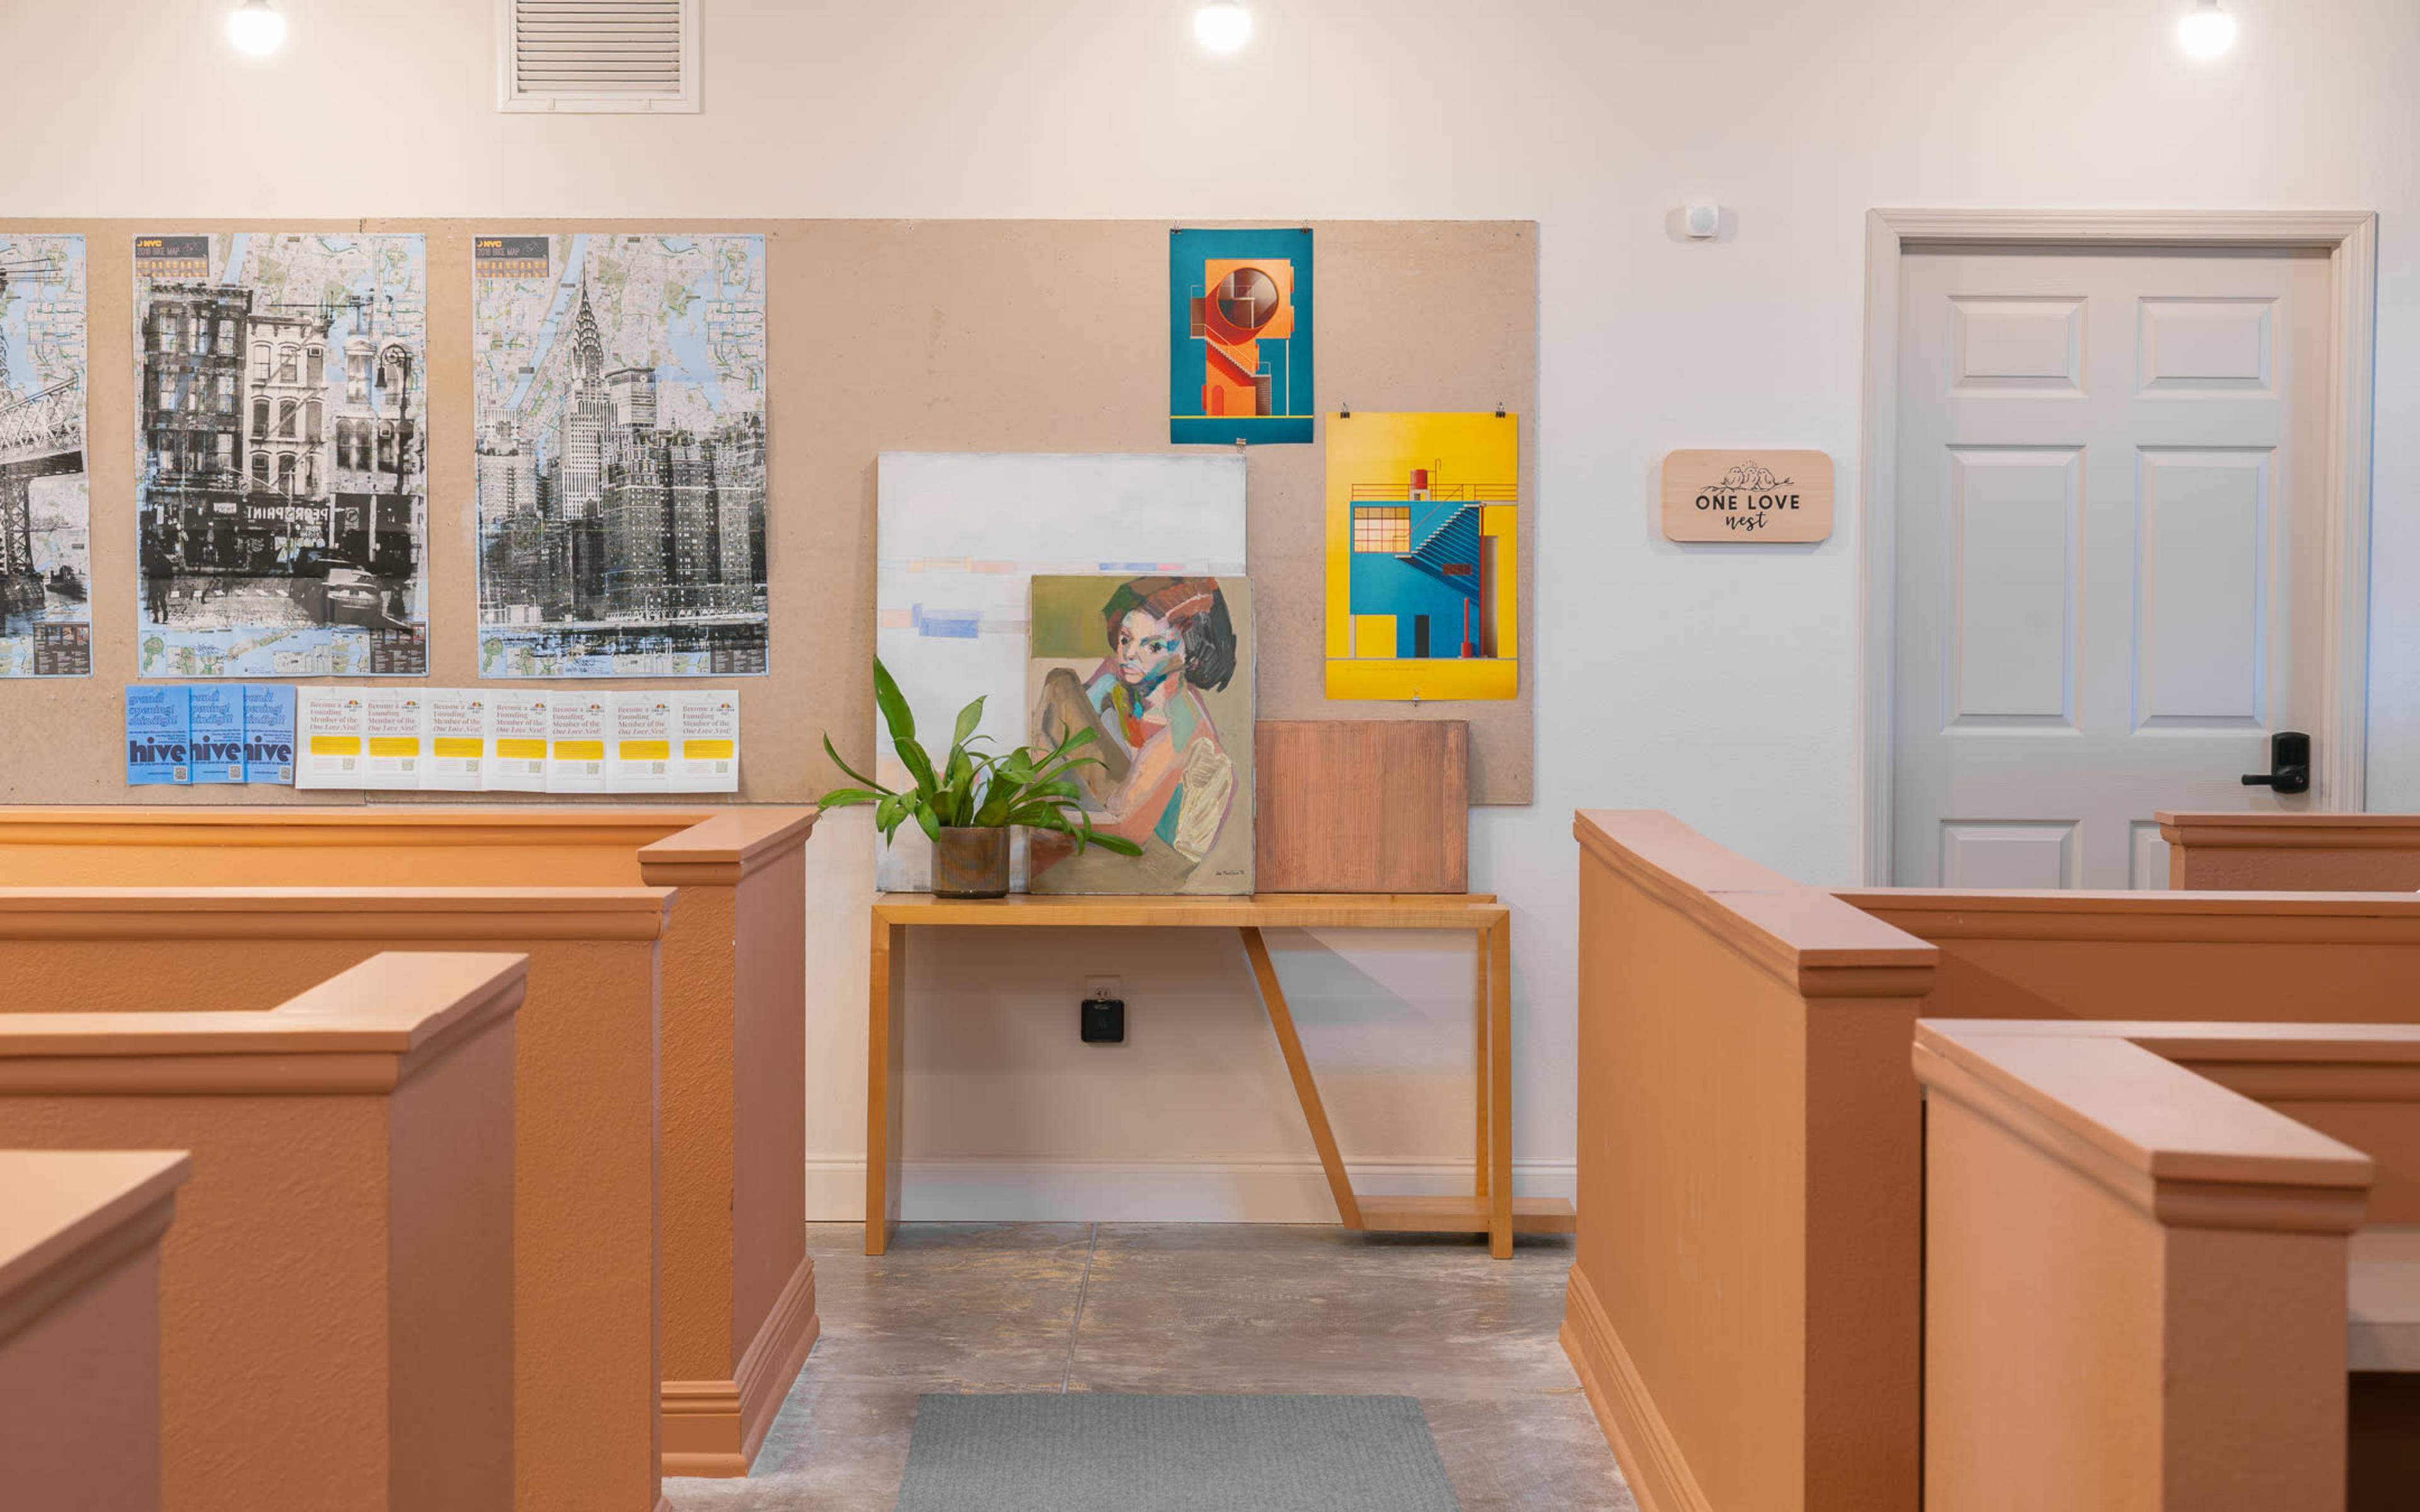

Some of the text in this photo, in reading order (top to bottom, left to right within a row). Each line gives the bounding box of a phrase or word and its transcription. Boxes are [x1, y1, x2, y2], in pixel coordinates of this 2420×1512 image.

[167, 247, 180, 256] MAP
[507, 247, 520, 256] MAP
[1695, 495, 1800, 510] ONE LOVE
[1726, 512, 1768, 531] nest
[190, 692, 220, 702] rand
[244, 692, 274, 702] rand
[190, 702, 231, 715] pening!
[244, 704, 283, 716] pening!
[130, 736, 187, 762] hive
